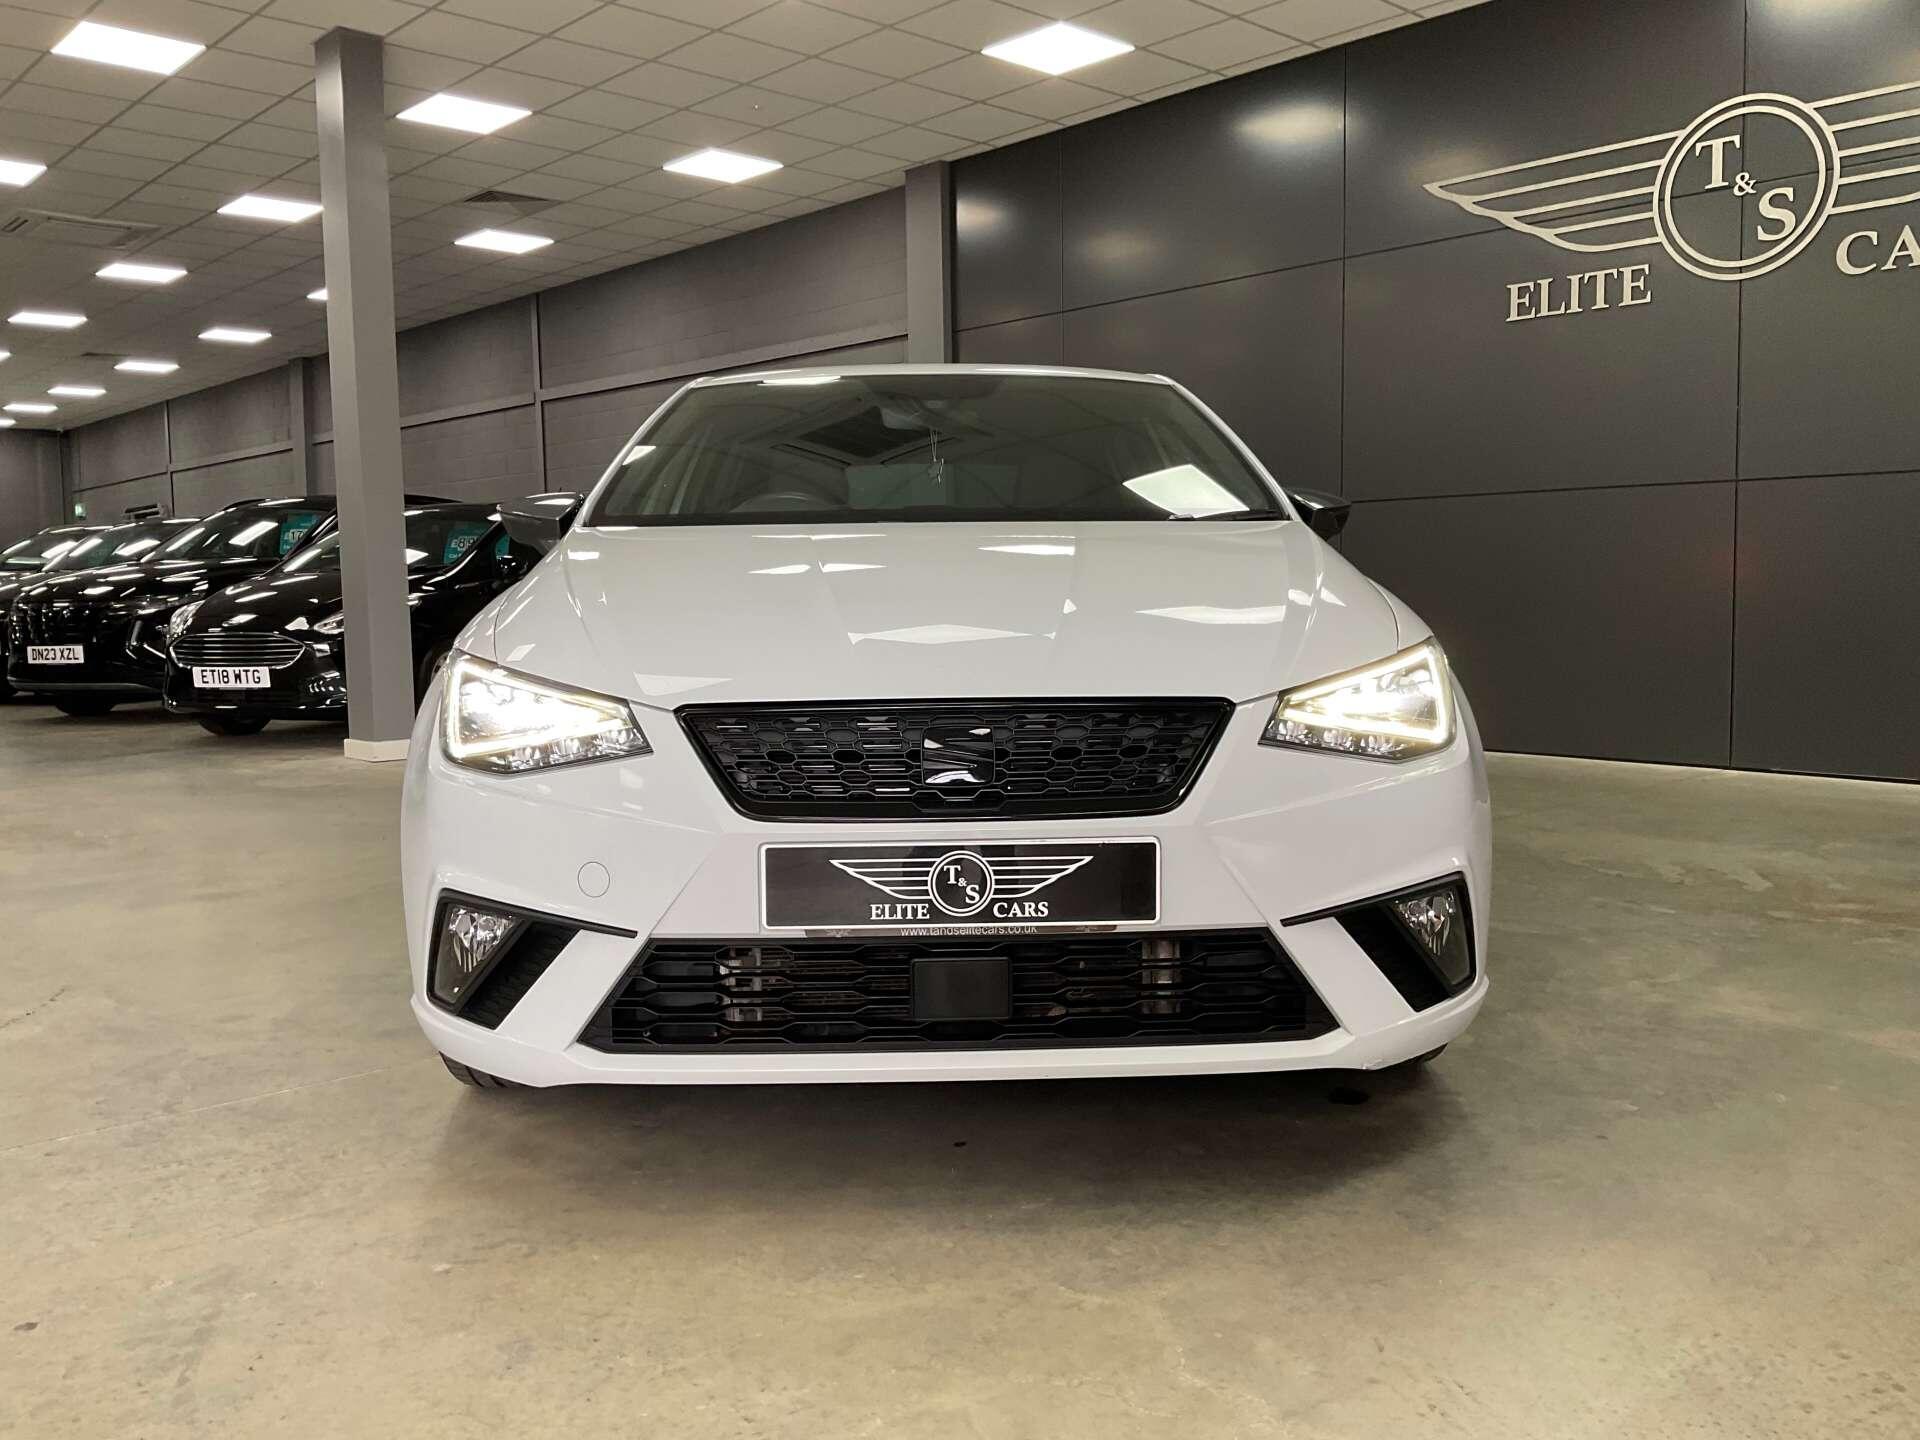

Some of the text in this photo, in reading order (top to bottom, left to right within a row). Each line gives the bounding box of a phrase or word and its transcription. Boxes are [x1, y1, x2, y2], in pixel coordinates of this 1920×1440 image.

[1695, 134, 1797, 241] T&S
[1505, 263, 1652, 322] ELITE
[31, 647, 80, 662] DN23 XZL
[201, 667, 261, 685] ET18 WTG
[943, 864, 981, 904] T&S
[870, 901, 1049, 920] ELITE CARS
